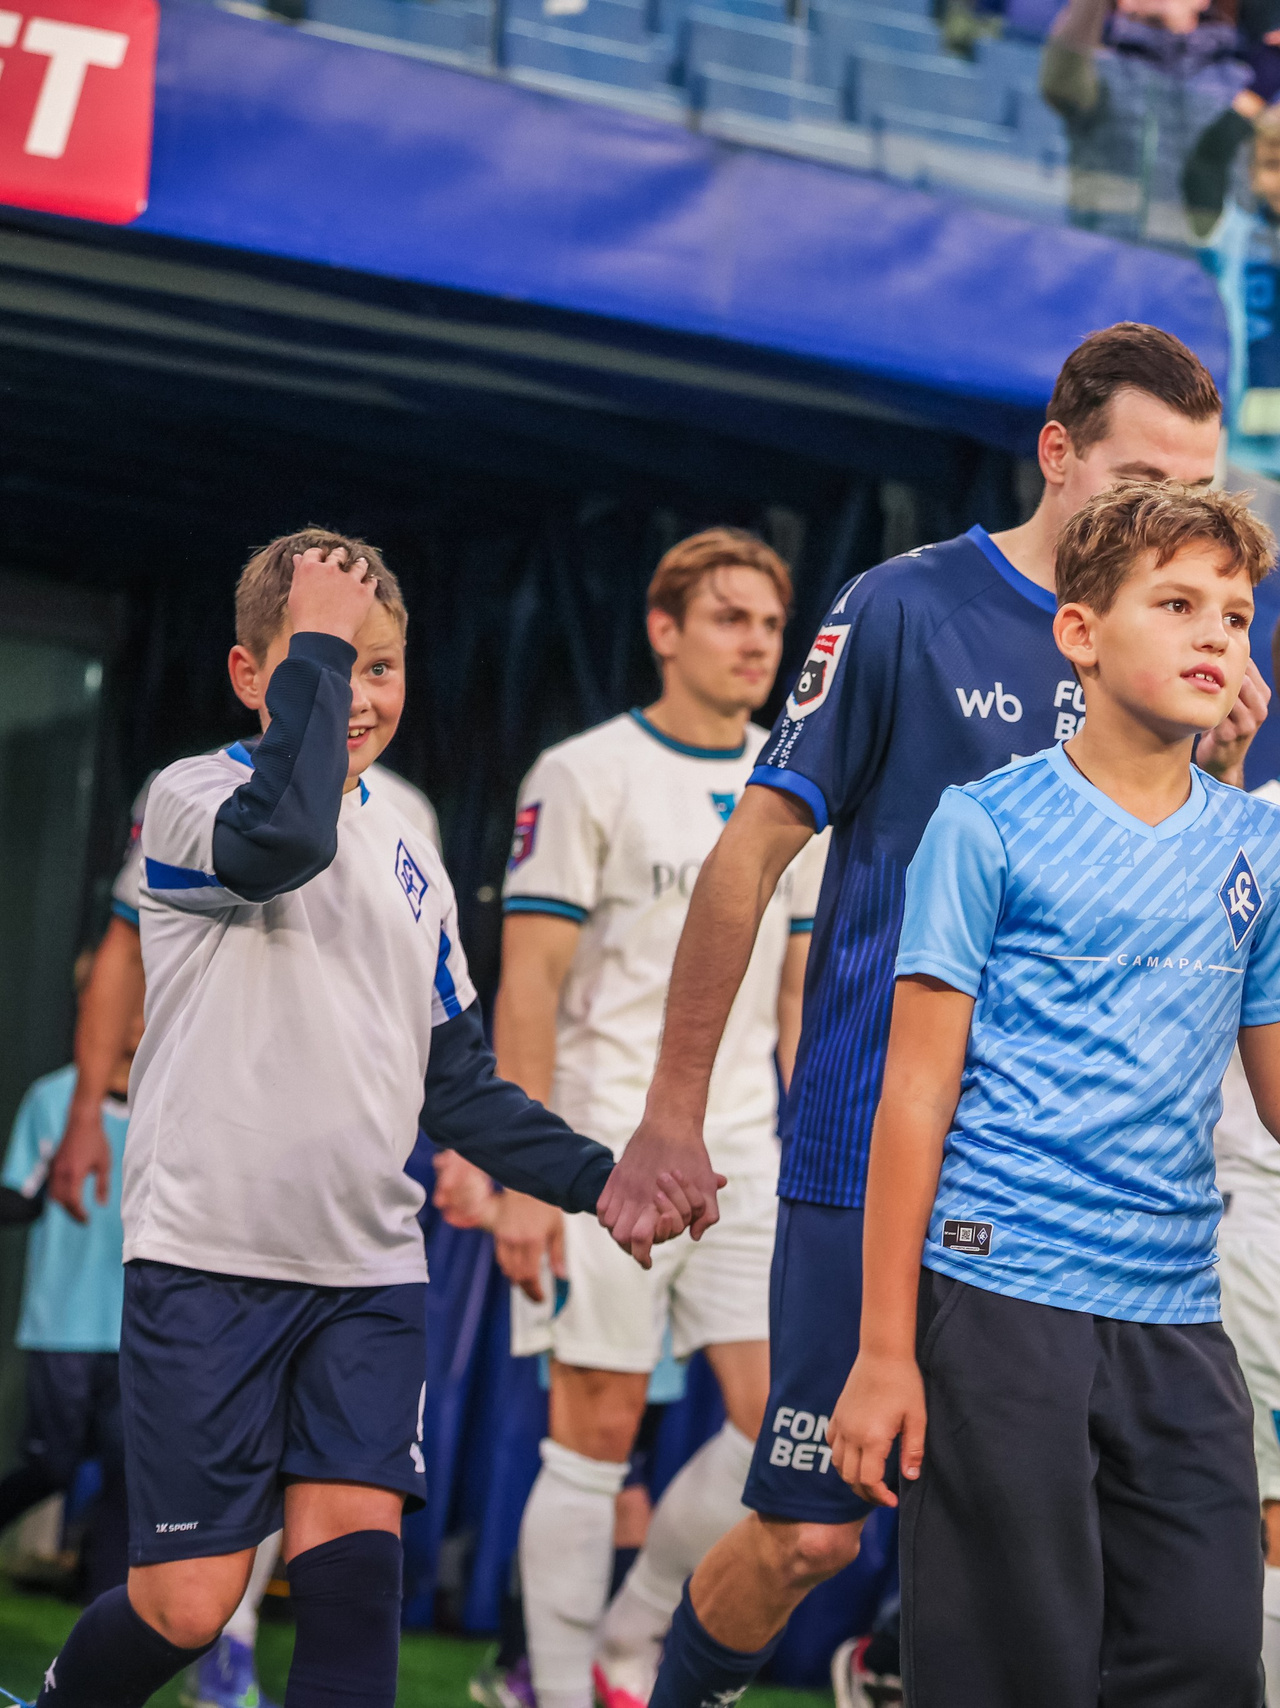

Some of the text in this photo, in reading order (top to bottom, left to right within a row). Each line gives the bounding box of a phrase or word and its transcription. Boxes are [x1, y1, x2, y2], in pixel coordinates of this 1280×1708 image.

[0, 9, 130, 160] T
[955, 681, 1023, 723] wb
[1117, 954, 1203, 971] САМАРА
[769, 1436, 833, 1474] BET
[168, 1521, 199, 1532] SPORT
